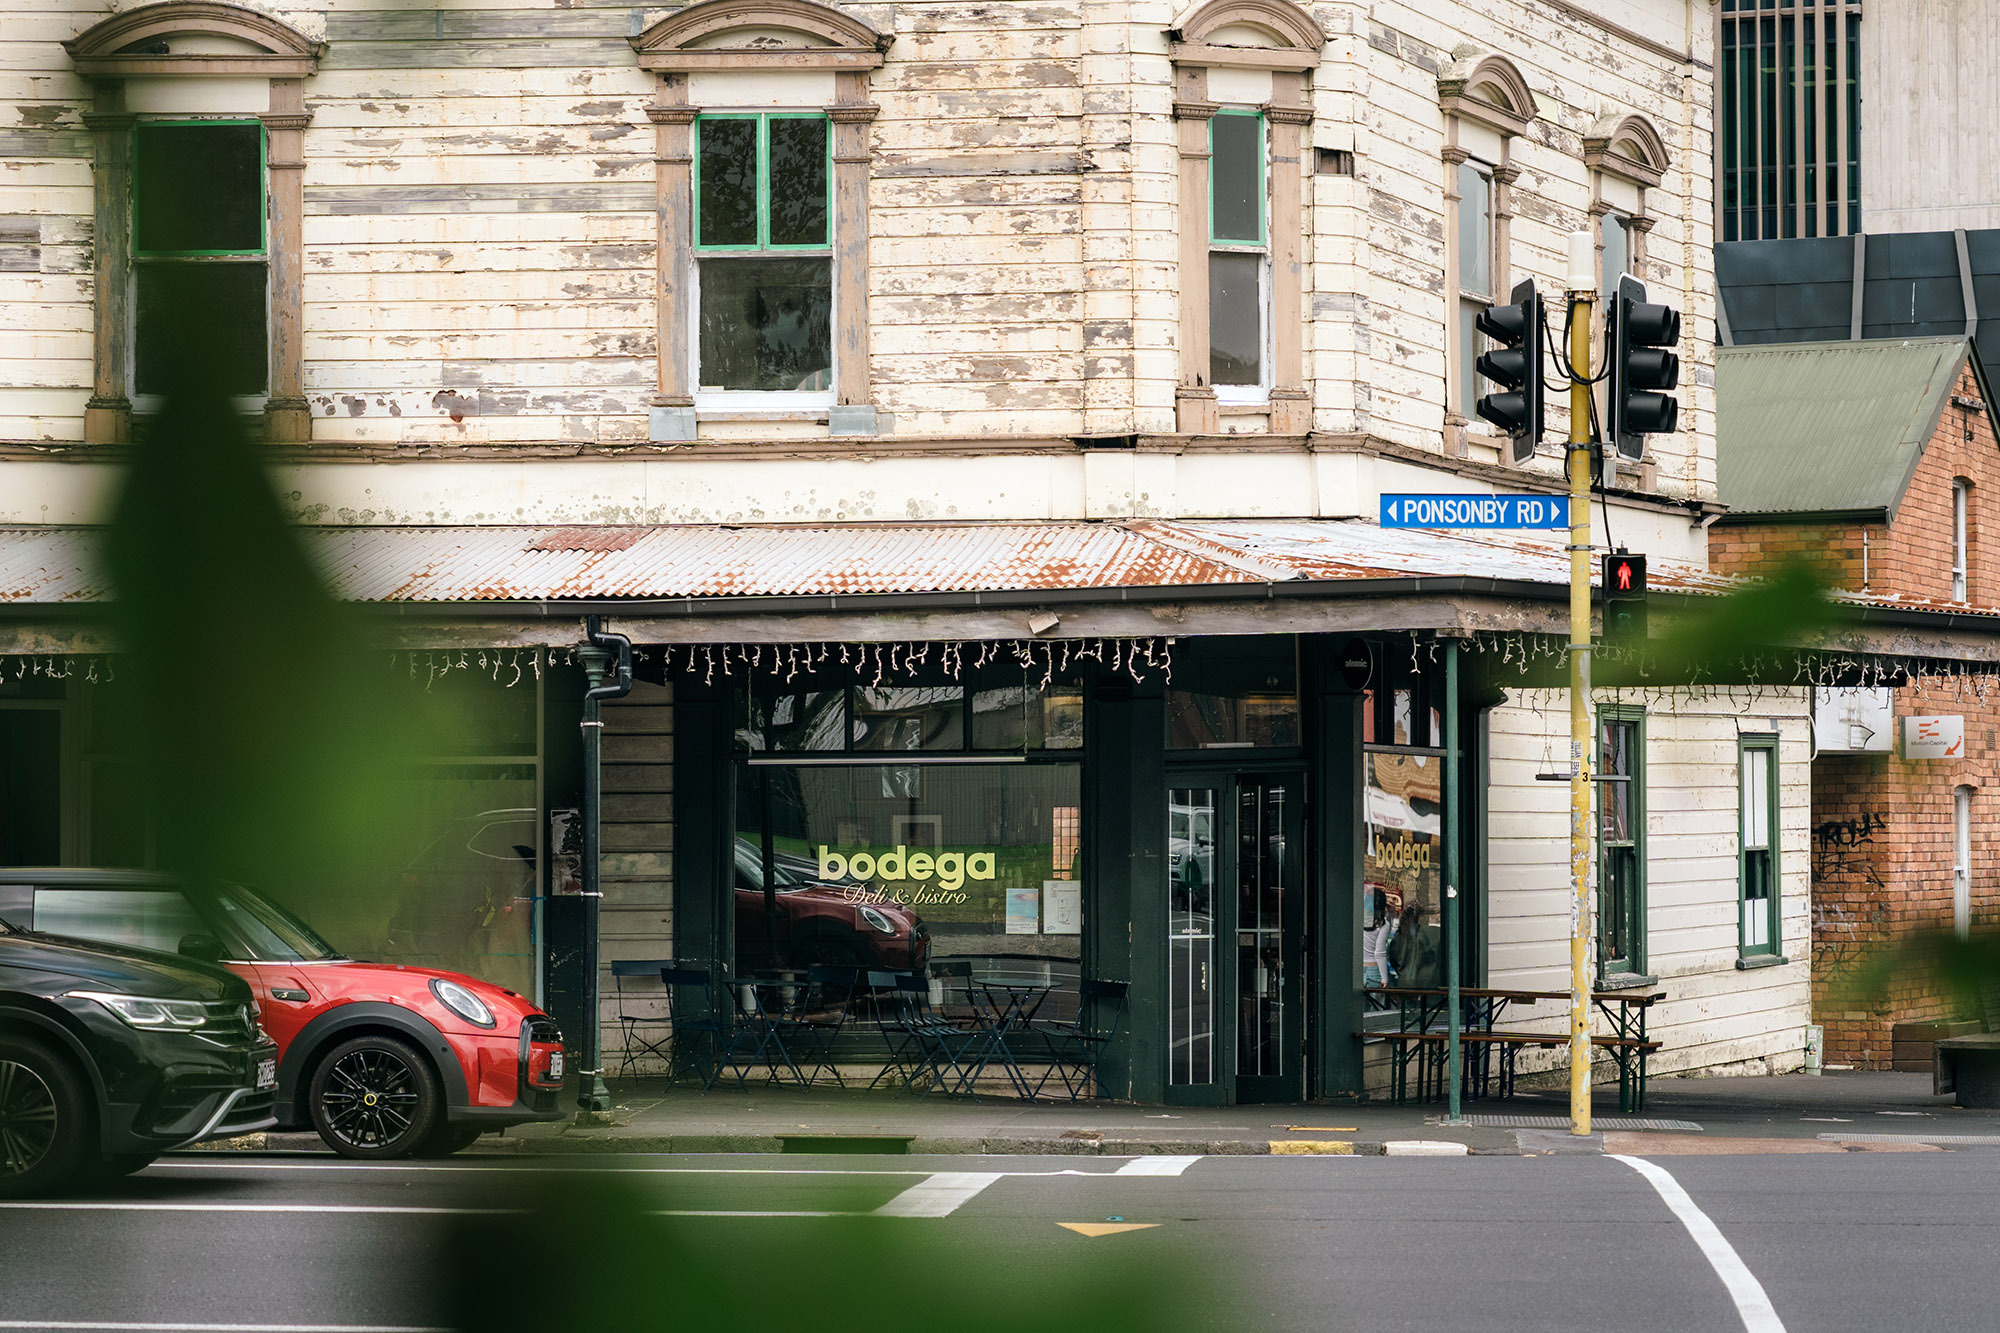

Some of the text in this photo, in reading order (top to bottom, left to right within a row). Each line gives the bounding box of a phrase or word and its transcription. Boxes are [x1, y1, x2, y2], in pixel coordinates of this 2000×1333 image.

[1404, 499, 1544, 524] PONSONBY RD
[1582, 772, 1588, 782] 3
[818, 844, 996, 891] bodega
[1375, 834, 1430, 879] bodega
[843, 881, 972, 905] Deli & bistro
